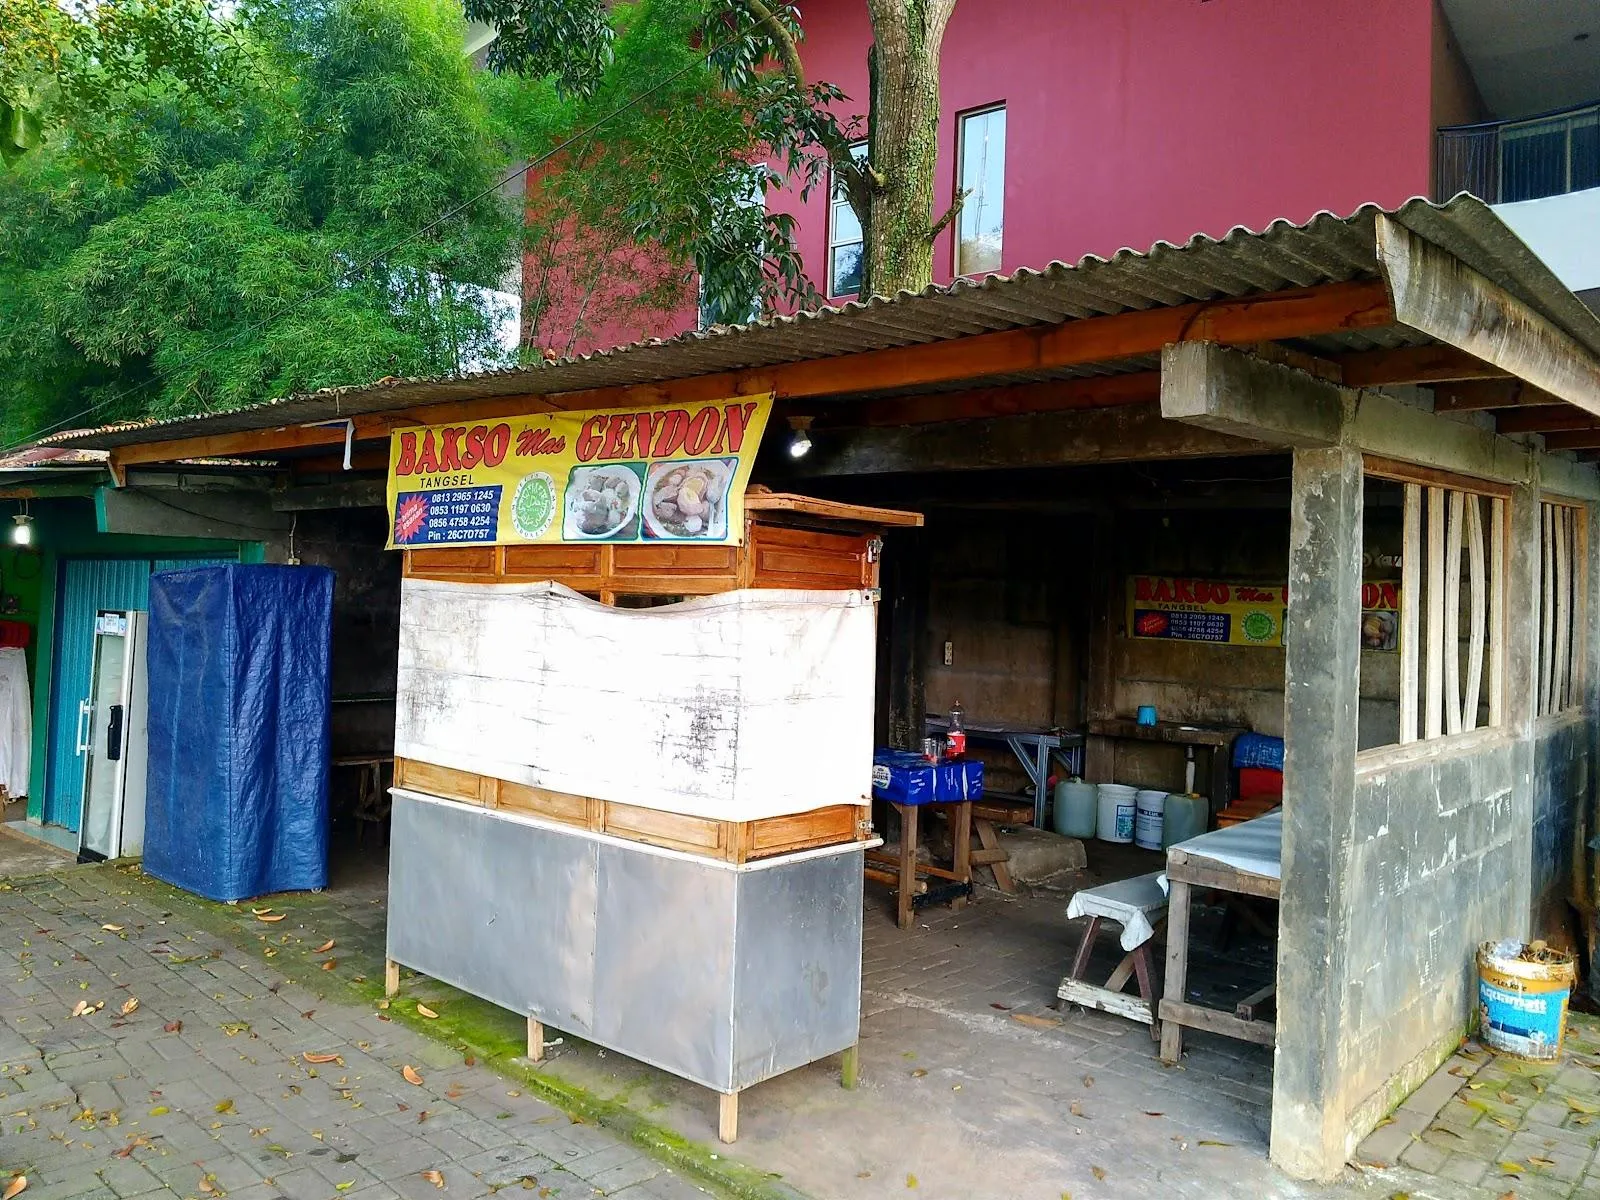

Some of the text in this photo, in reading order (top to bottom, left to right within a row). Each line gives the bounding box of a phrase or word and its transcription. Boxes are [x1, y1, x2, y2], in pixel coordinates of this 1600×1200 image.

[396, 402, 757, 476] BAKSO Mas GENDON
[419, 475, 475, 489] TANGSEL
[432, 490, 494, 503] 0813 2965 1245
[430, 503, 491, 515] 0853 1197 0630
[429, 515, 490, 528] 0856 4758 4254
[428, 530, 441, 541] Pin
[447, 529, 490, 540] 26C7D757
[1134, 576, 1230, 604] BAKSO
[1235, 587, 1274, 602] Mas
